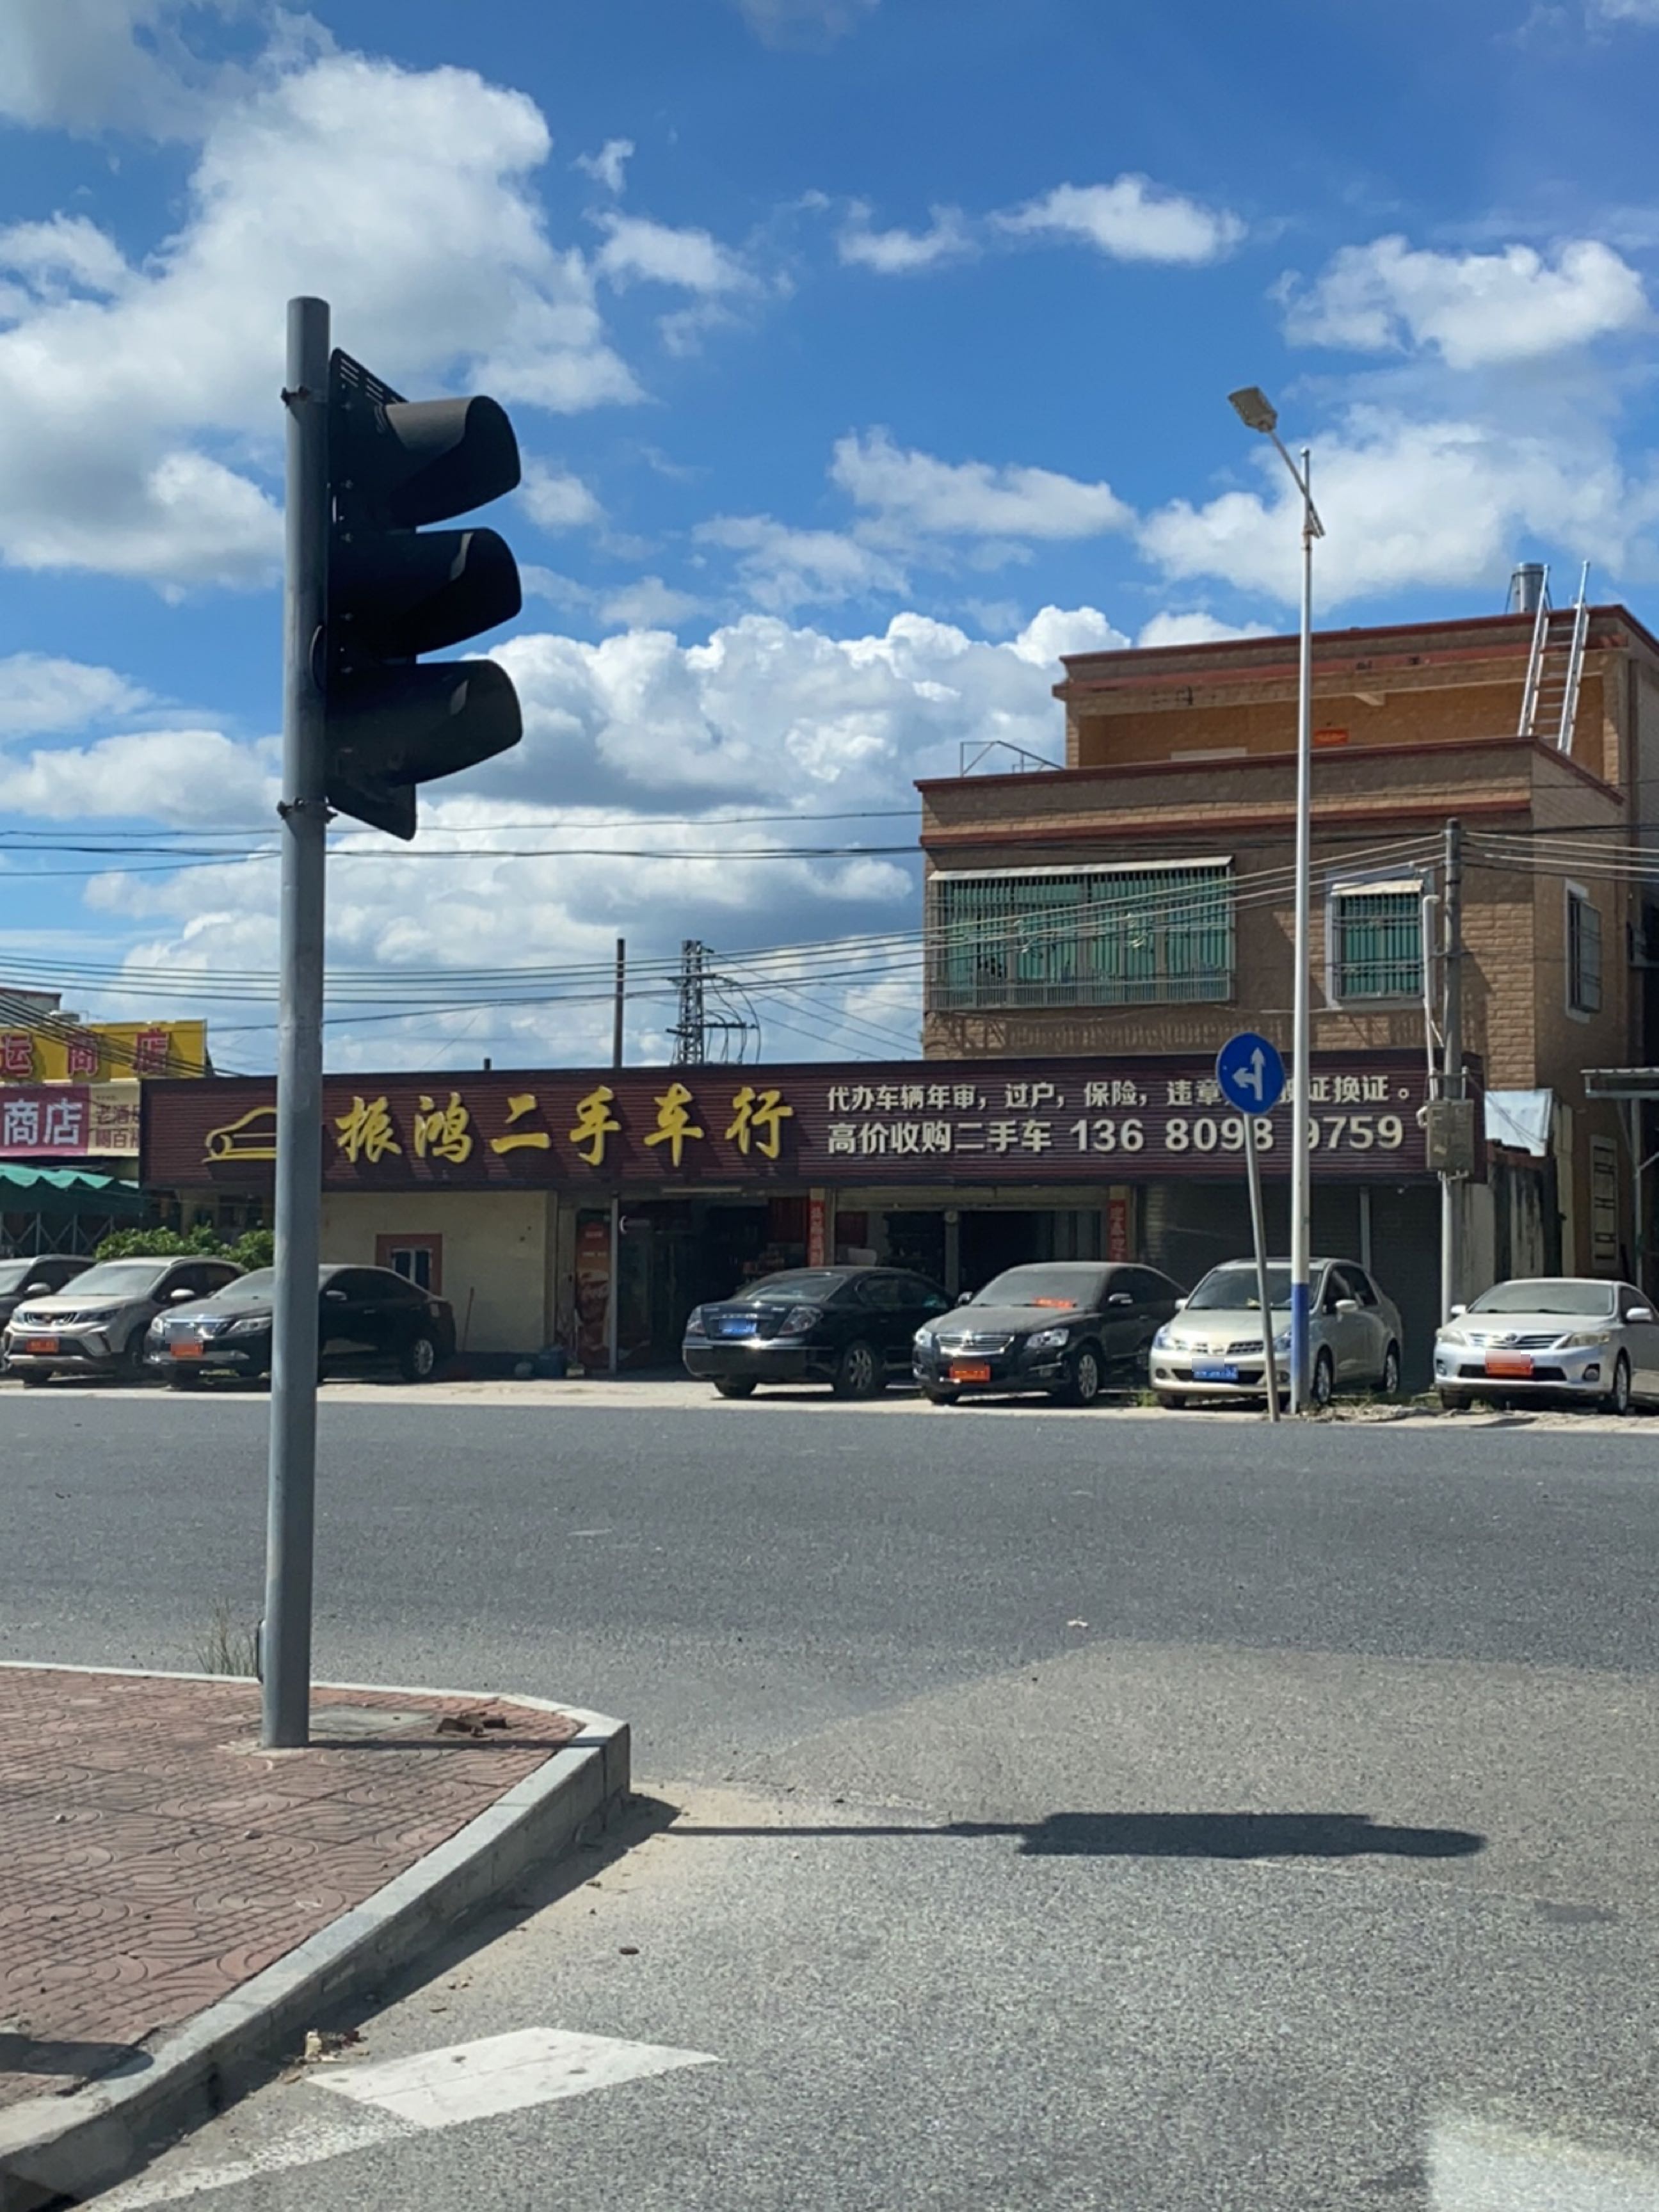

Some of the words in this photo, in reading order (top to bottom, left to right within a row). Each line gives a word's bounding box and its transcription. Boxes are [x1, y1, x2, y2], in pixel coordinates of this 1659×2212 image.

[3, 1097, 83, 1147] 商店
[335, 1082, 794, 1167] 振鸿二手车行
[828, 1119, 1052, 1154] 高价收购二手车
[1070, 1119, 1144, 1152] 136
[1165, 1117, 1273, 1151] 8098
